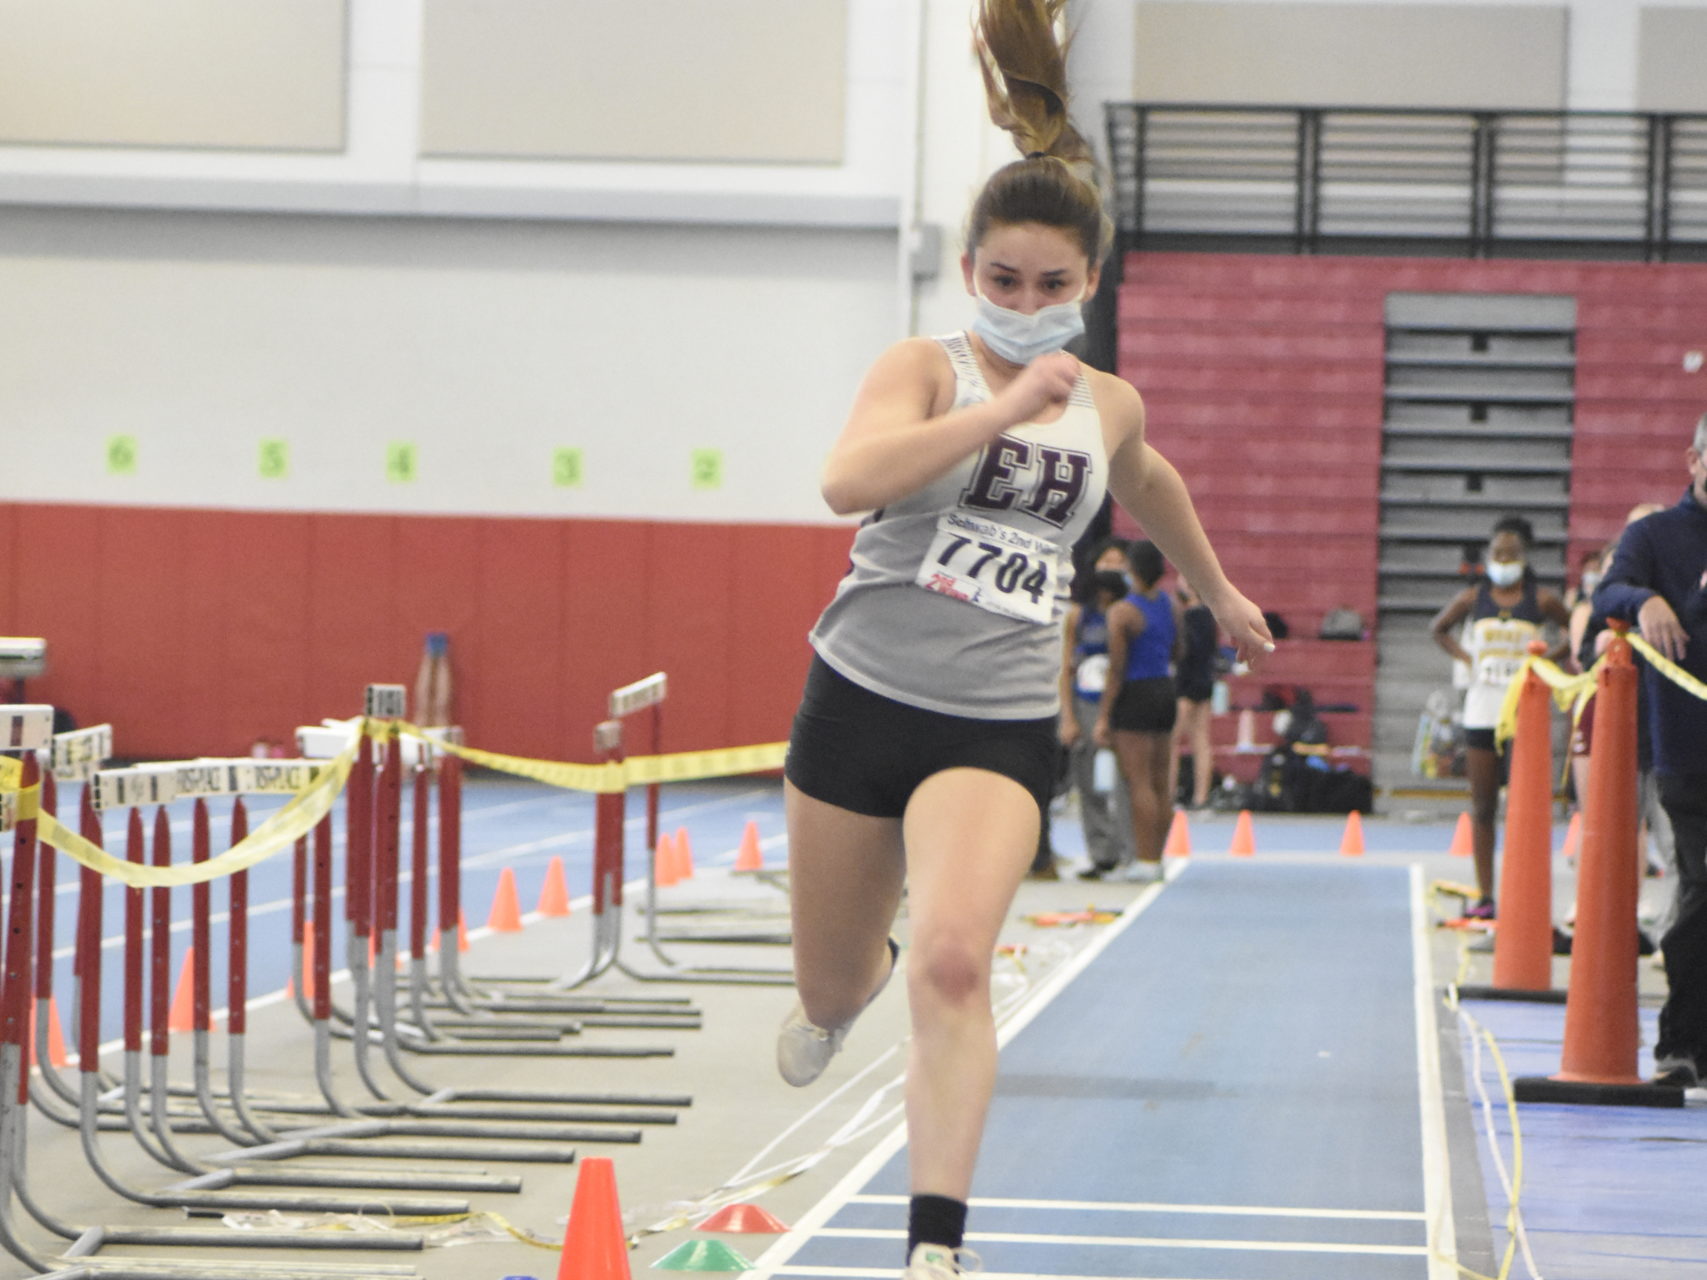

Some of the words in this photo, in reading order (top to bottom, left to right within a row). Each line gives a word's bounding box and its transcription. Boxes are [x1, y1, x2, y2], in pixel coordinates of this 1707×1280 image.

[957, 432, 1093, 530] EH
[947, 512, 1006, 540] Schwab's
[937, 532, 1048, 604] 7704
